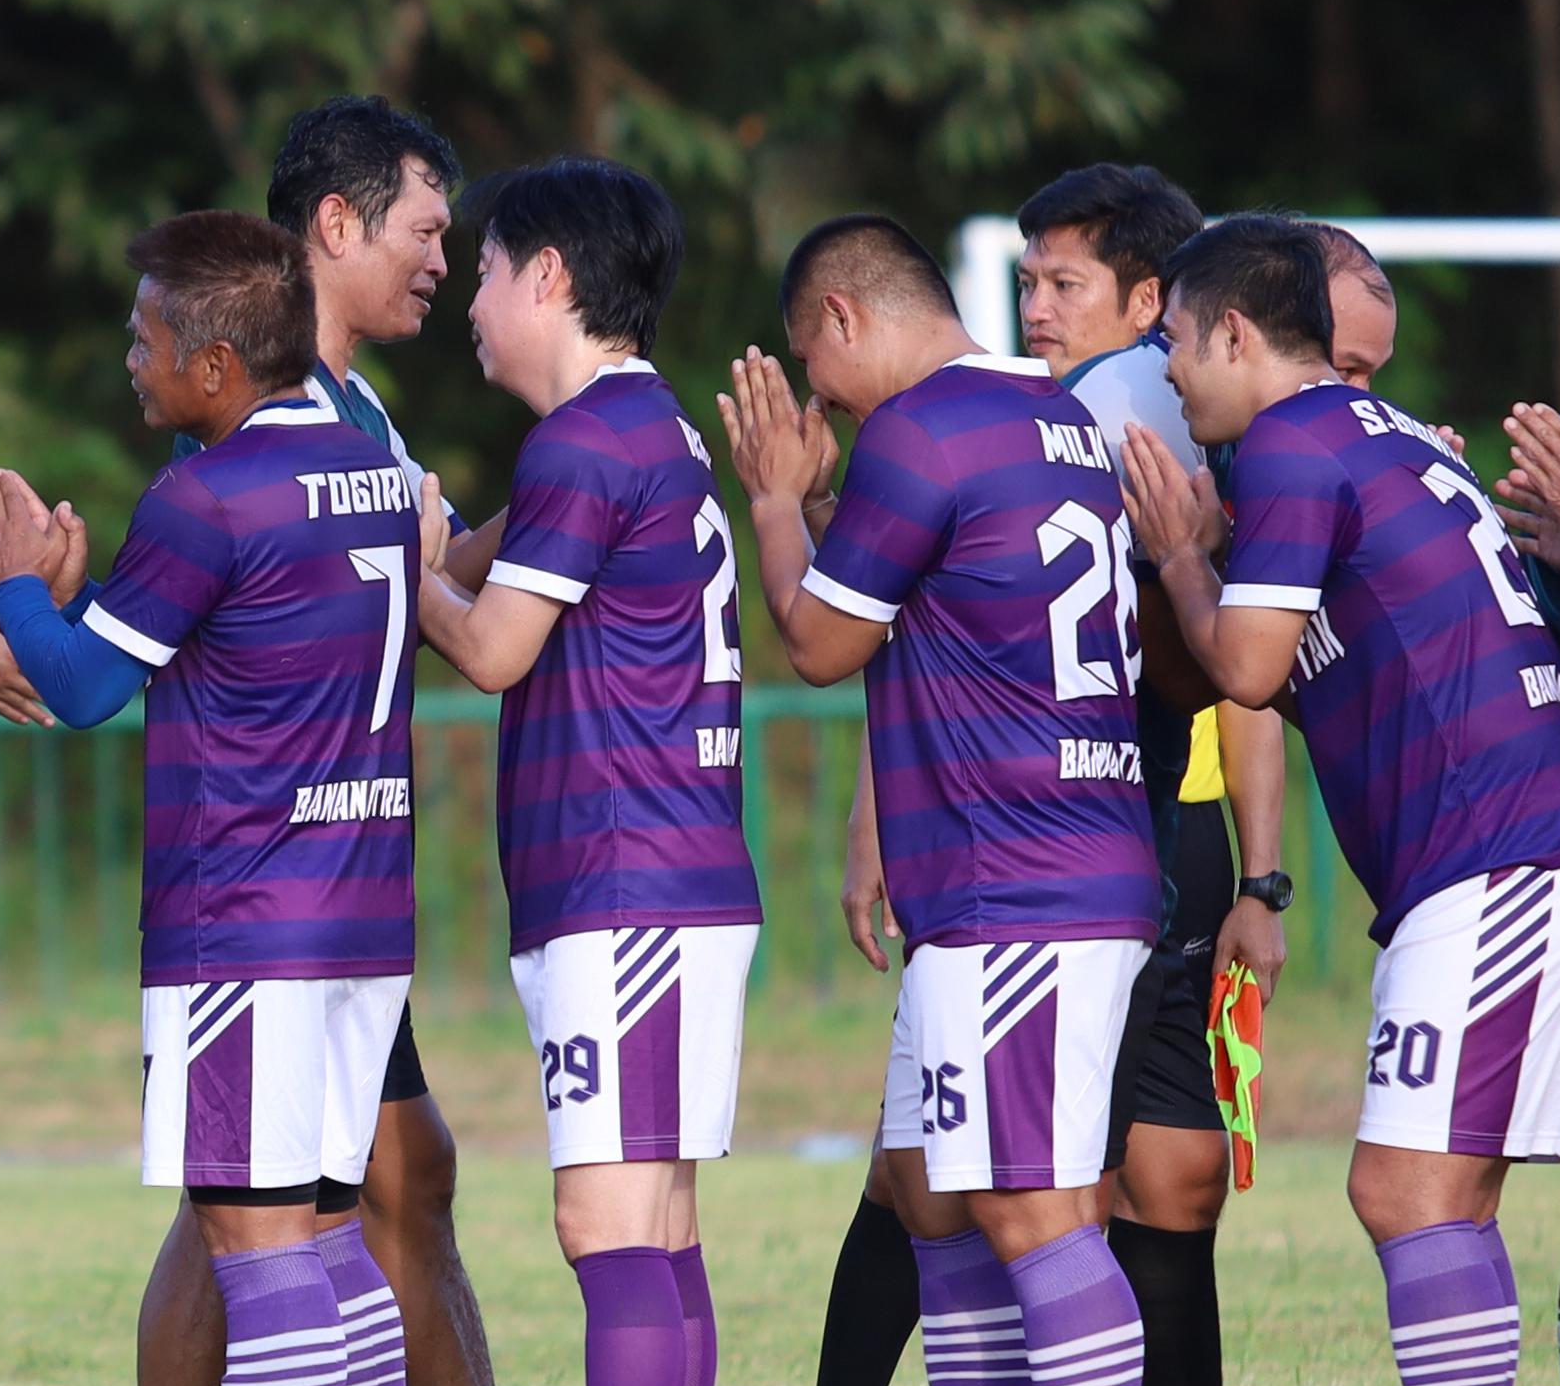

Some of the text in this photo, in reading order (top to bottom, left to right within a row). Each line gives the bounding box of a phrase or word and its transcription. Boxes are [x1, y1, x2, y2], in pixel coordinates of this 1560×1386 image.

[347, 544, 408, 734] 7
[542, 1032, 602, 1112] 29
[1368, 1019, 1443, 1090] 20
